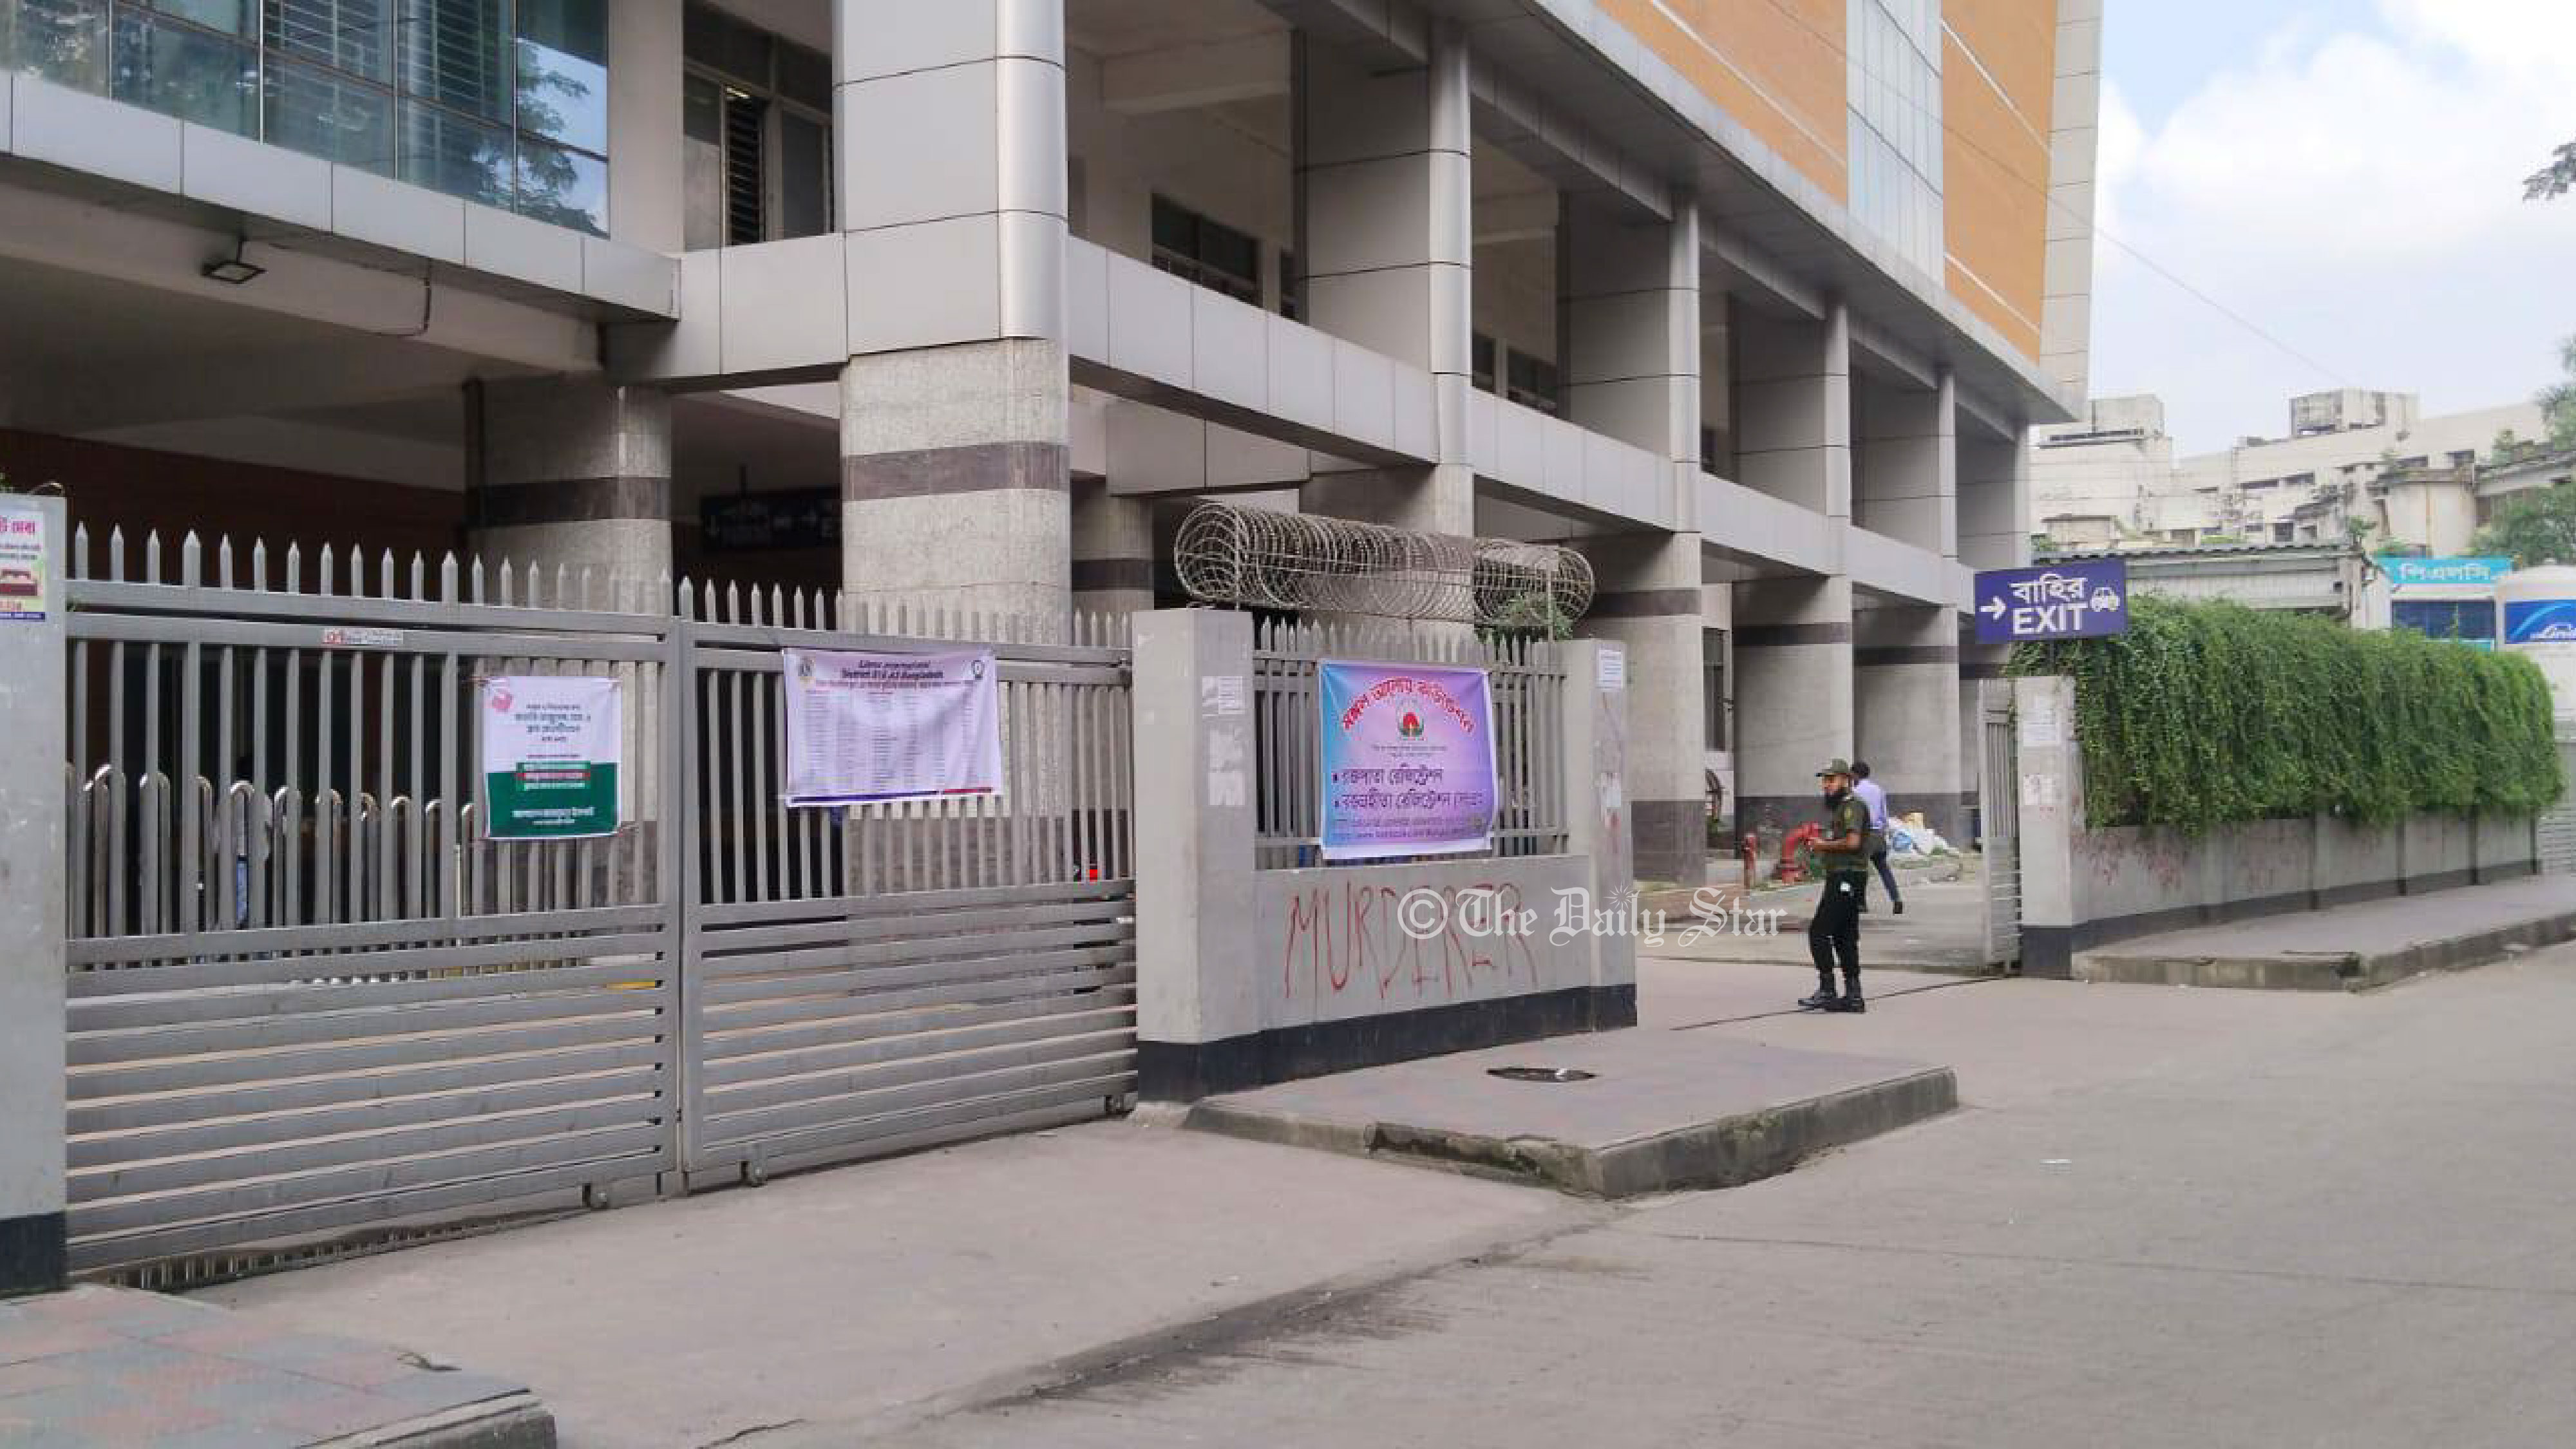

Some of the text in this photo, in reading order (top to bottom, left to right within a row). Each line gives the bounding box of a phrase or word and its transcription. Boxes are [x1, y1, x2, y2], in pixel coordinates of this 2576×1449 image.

[2009, 572, 2088, 604] বাহির
[2012, 602, 2088, 634] EXIT
[1284, 880, 1539, 999] MURDERER
